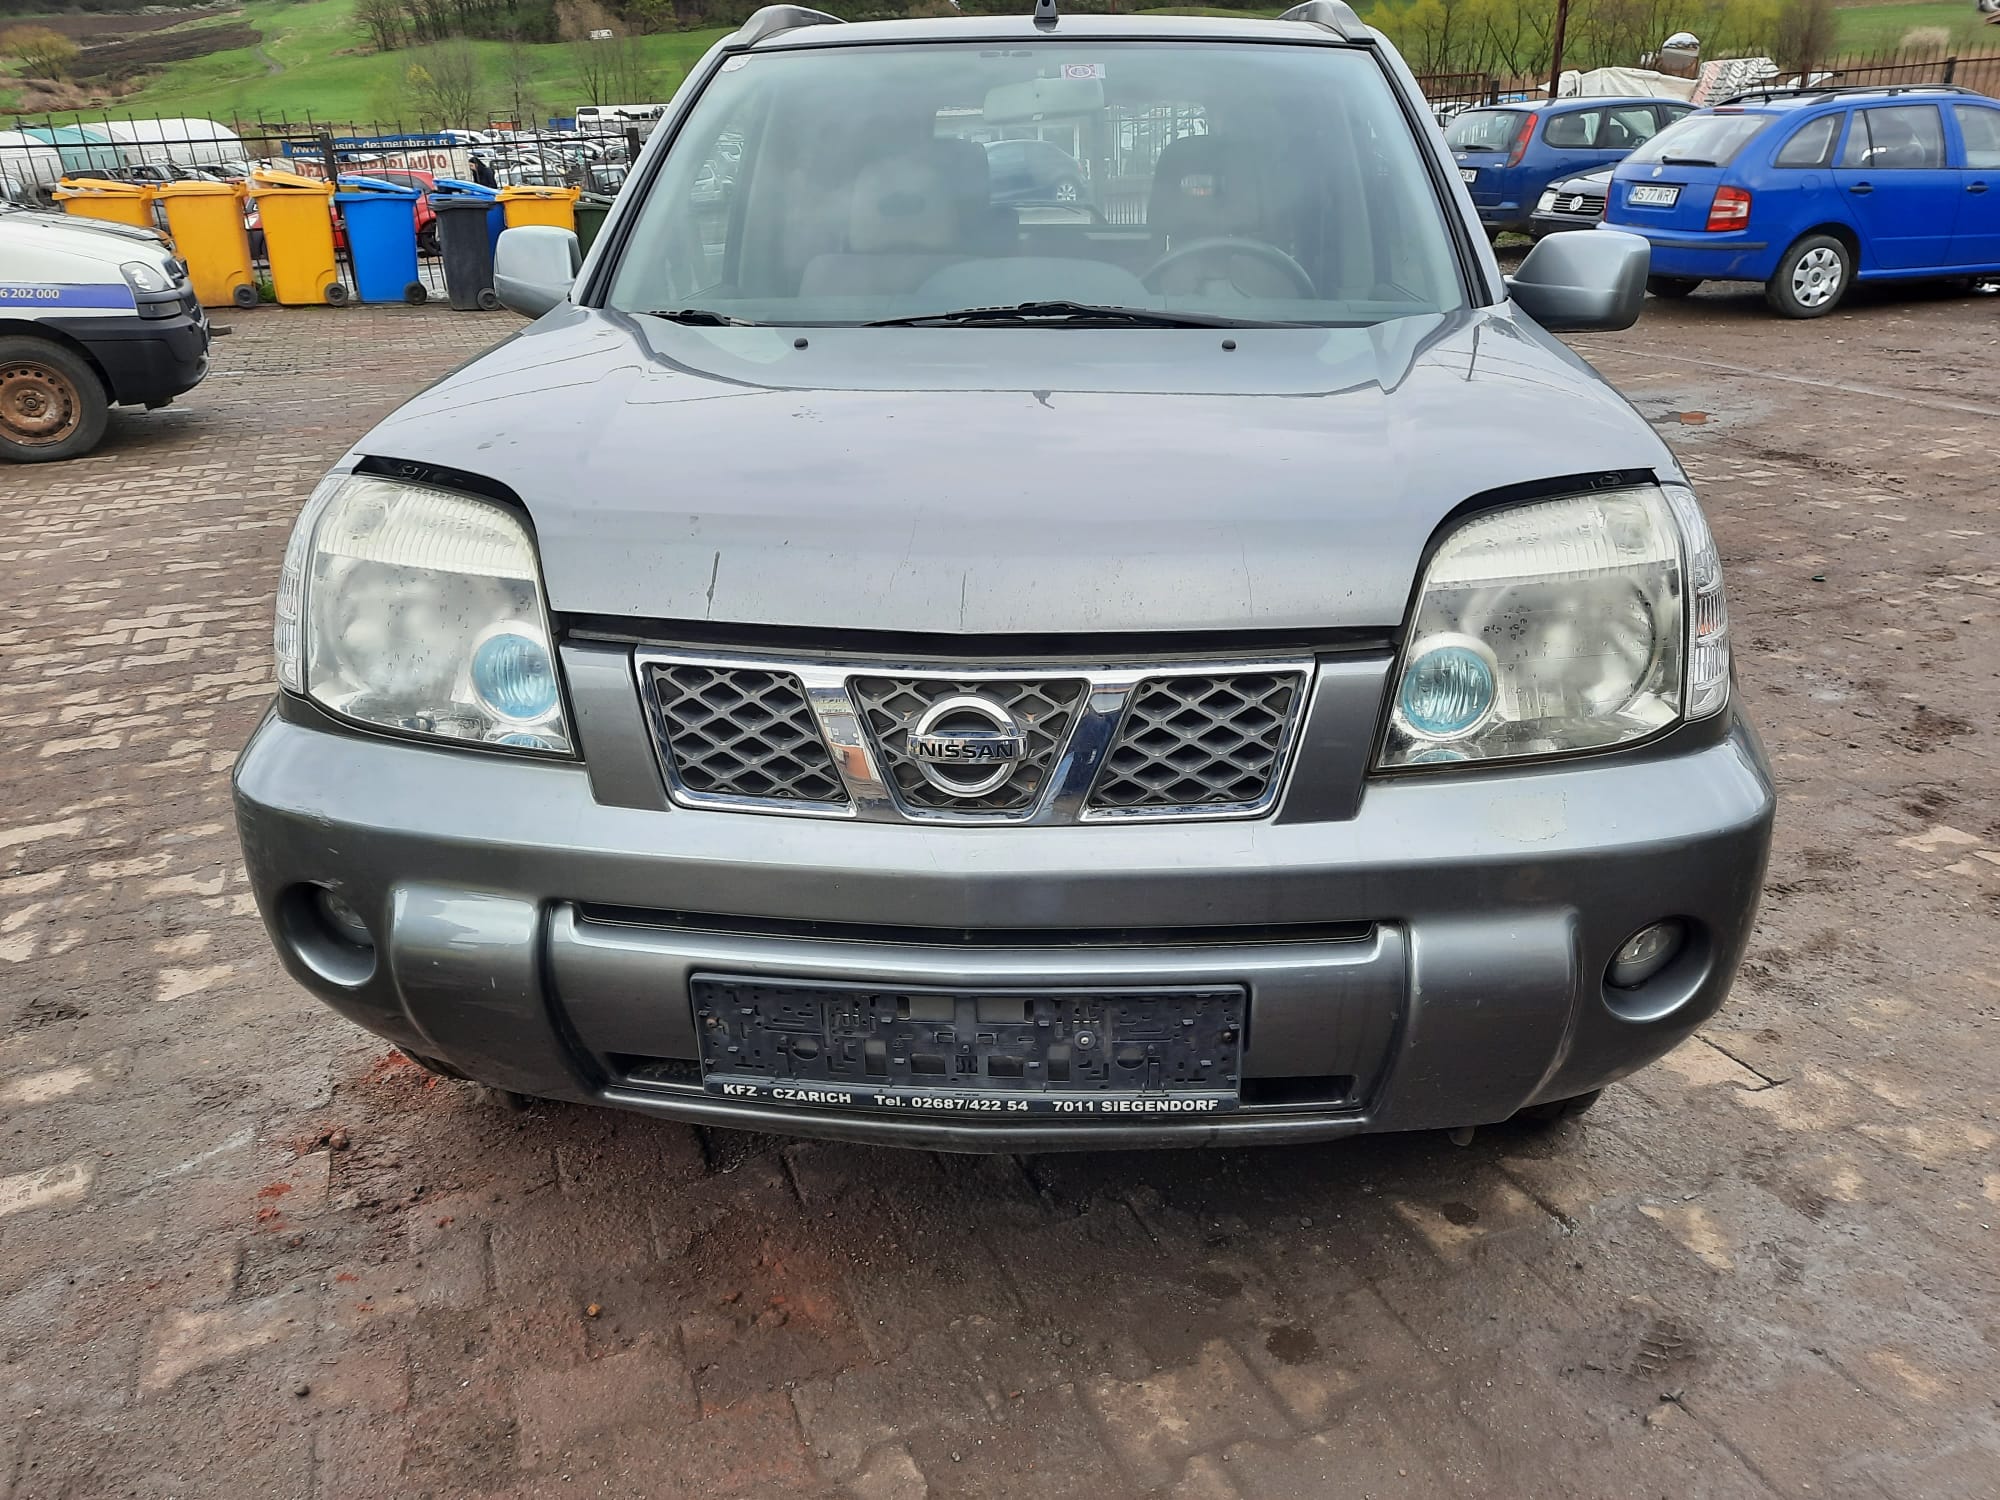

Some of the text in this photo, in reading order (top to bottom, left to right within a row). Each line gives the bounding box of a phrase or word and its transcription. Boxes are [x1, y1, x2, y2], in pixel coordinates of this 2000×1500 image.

[408, 154, 448, 170] AUTO
[10, 288, 34, 299] 202
[36, 289, 60, 299] 000
[919, 742, 1013, 759] NISSAN
[723, 1083, 758, 1097] KFZ
[772, 1088, 852, 1104] CZARICH
[874, 1094, 907, 1108] Tel.
[911, 1097, 1002, 1111] 02687/422
[1007, 1100, 1029, 1112] 54
[1053, 1100, 1095, 1112] 7011
[1101, 1099, 1219, 1113] SIEGENDORF
